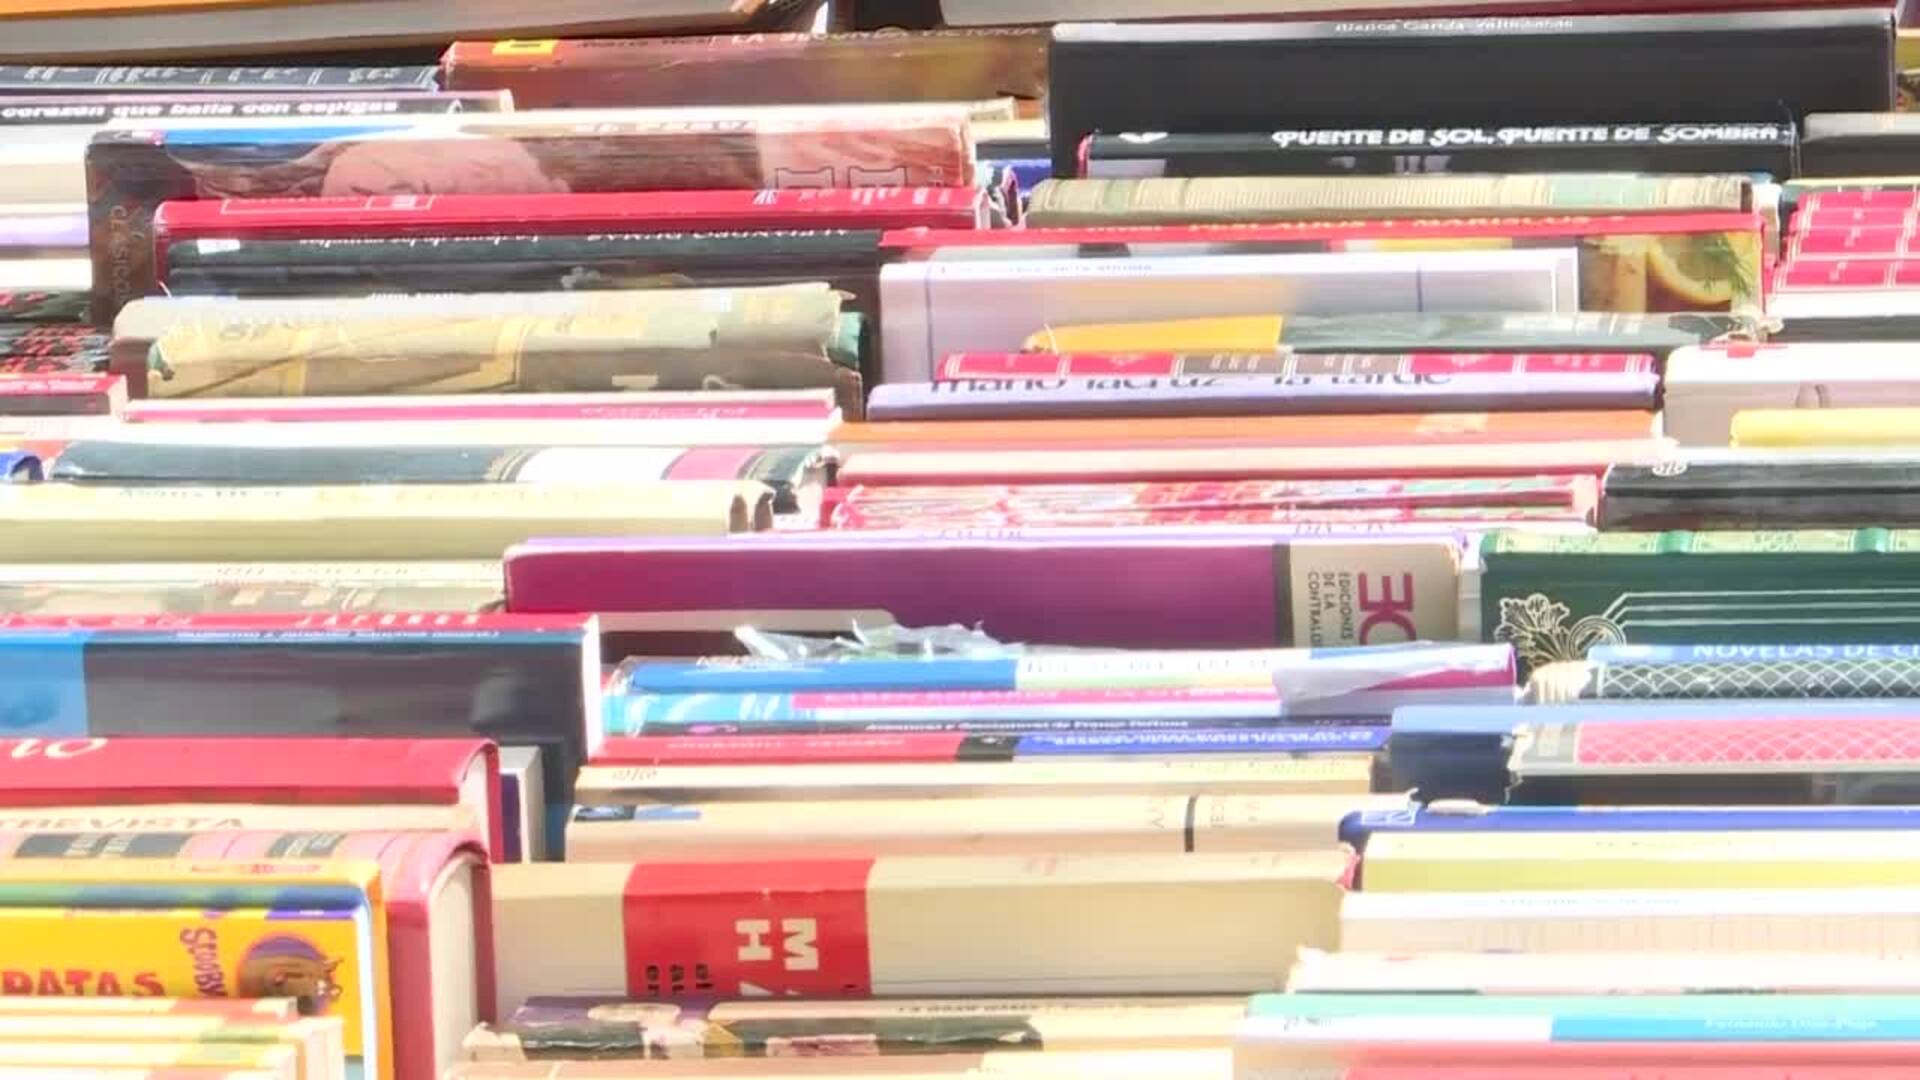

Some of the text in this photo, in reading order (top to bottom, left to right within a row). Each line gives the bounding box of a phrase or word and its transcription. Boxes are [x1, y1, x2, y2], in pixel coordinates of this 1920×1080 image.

[112, 105, 161, 118] que
[169, 103, 233, 115] baila
[242, 103, 289, 114] con
[298, 101, 397, 115] espigas
[1272, 125, 1778, 148] PUENTE DE SOL, PUENTE DE SOMBRA
[1323, 571, 1336, 610] DE LA
[1338, 571, 1354, 640] EDICIONES
[1692, 644, 1834, 659] NOVELAS
[1842, 644, 1880, 658] DE
